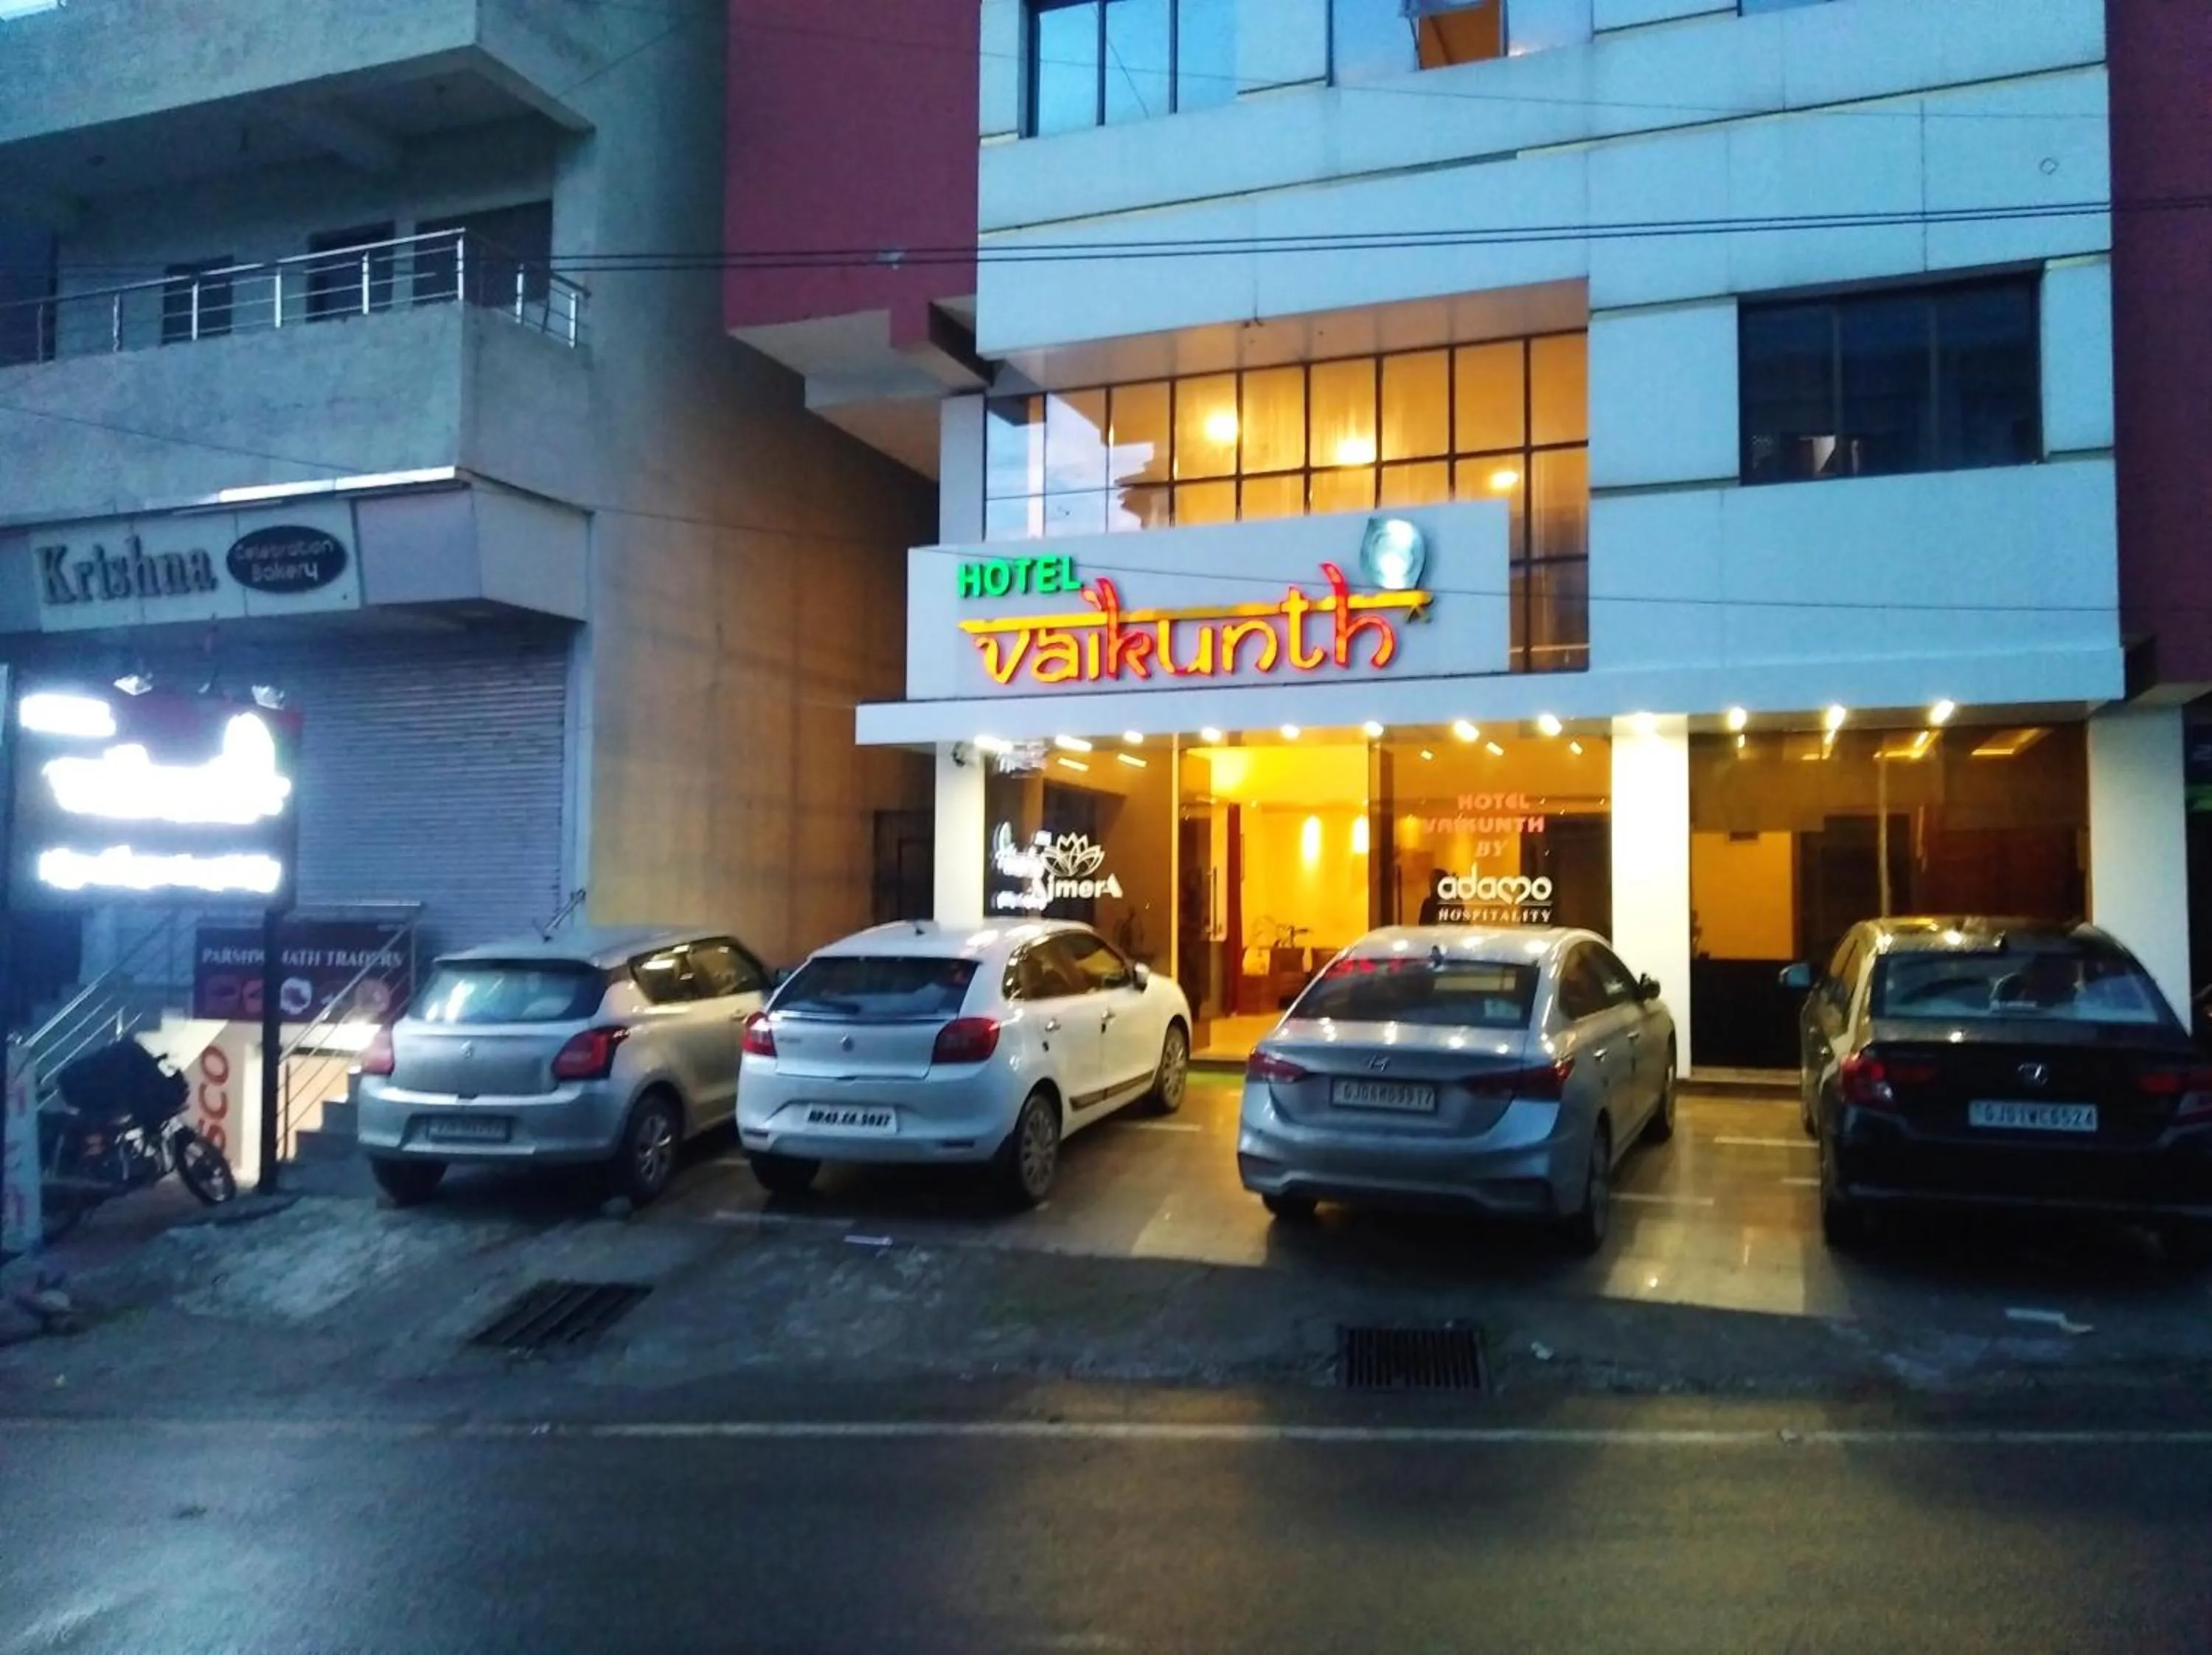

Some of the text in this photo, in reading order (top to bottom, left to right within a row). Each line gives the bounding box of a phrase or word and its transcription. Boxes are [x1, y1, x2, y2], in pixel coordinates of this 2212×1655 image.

[37, 534, 218, 604] Krishna
[958, 554, 1085, 598] HOTEL
[1457, 793, 1531, 811] HOTEL
[1476, 840, 1508, 858] BY
[1438, 907, 1553, 923] HOSPITALITY
